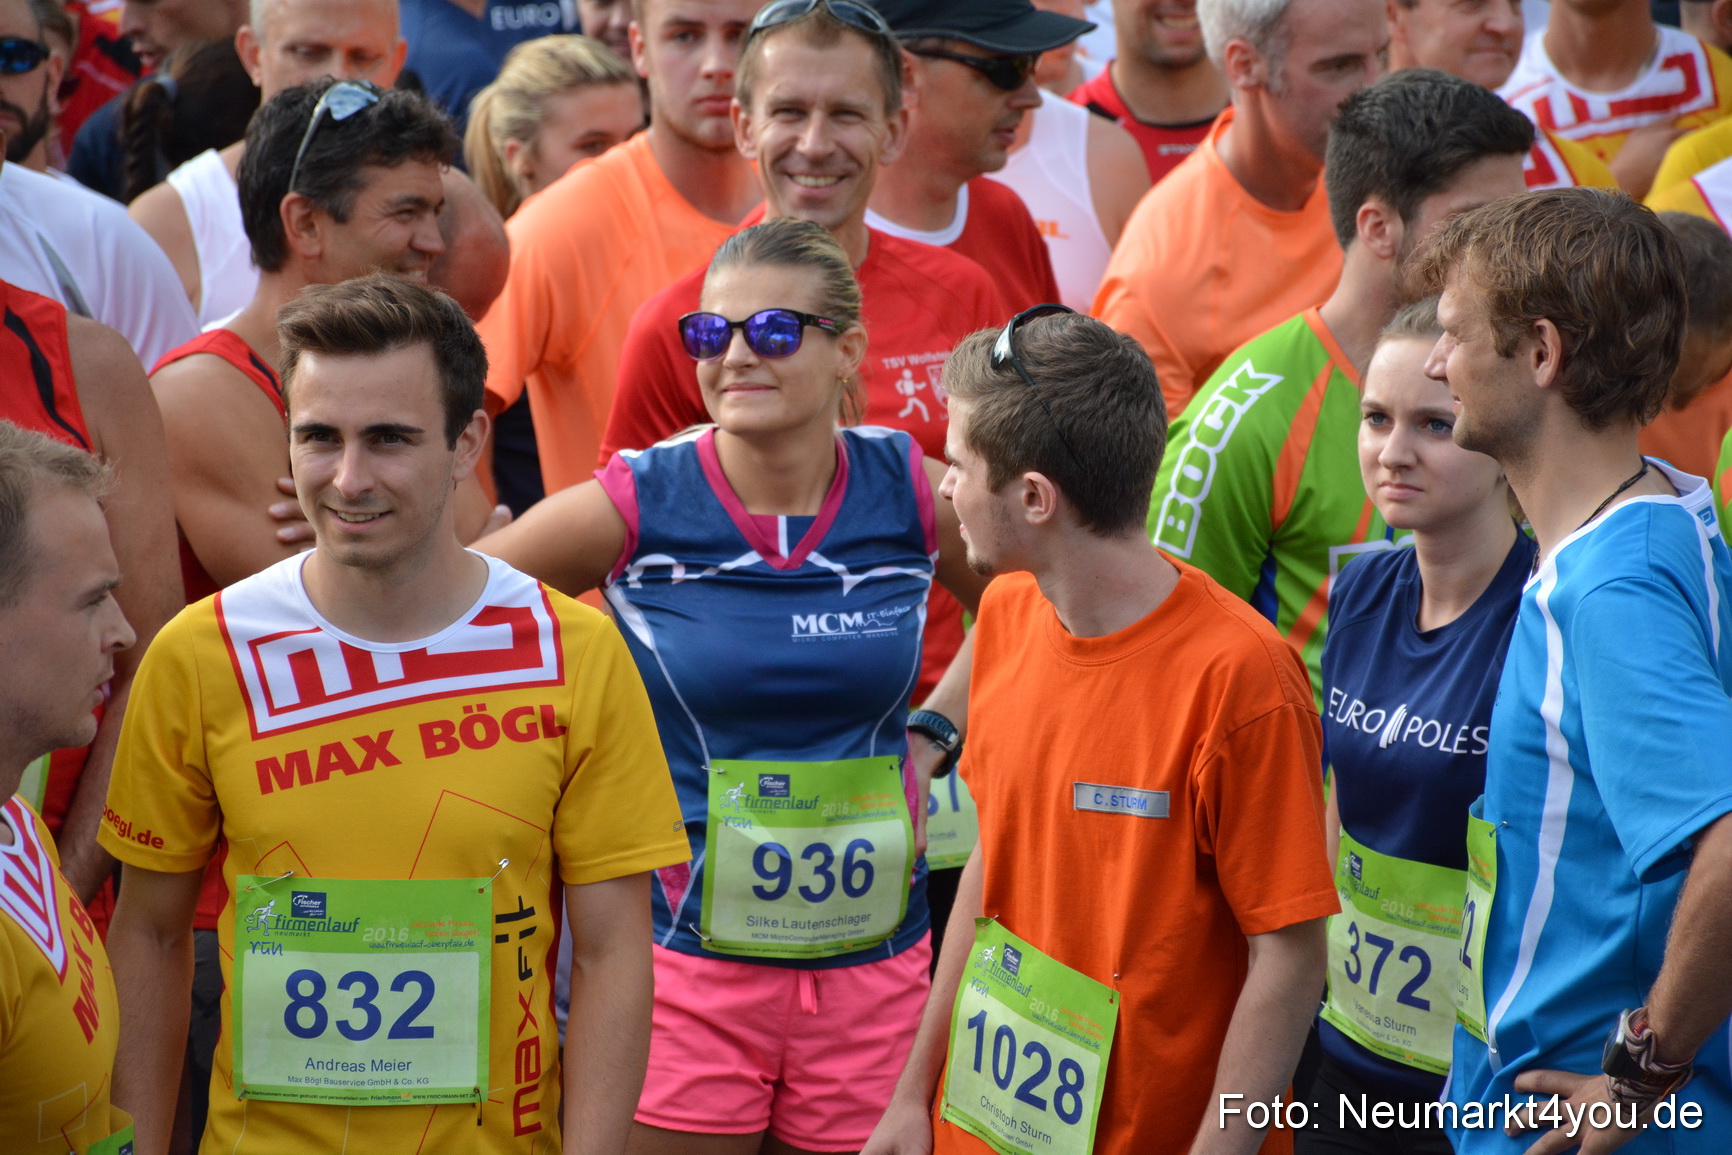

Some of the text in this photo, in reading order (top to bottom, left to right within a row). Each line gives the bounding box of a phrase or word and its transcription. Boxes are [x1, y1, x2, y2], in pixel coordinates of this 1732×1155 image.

[490, 3, 559, 30] EURO
[1153, 358, 1285, 560] BOCK
[792, 612, 863, 634] MCM
[1329, 686, 1489, 755] EURO POLES
[255, 702, 568, 796] MAX BÖGL
[744, 795, 820, 812] firmenlauf
[821, 802, 849, 817] 2016
[751, 838, 876, 903] 936
[292, 894, 322, 906] Fischer
[1381, 898, 1415, 918] 2016
[275, 917, 361, 933] firmenlauf
[746, 912, 872, 930] Silke Lautenschlager
[362, 927, 410, 942] 2016
[1344, 921, 1432, 1012] 372
[991, 960, 1033, 998] firmenlauf
[284, 969, 435, 1041] 832
[1029, 997, 1060, 1022] 2016
[1384, 1016, 1417, 1037] Sturm
[304, 1057, 412, 1073] Andreas Meier
[967, 1009, 1085, 1125] 1028
[304, 1076, 322, 1086] Bögl
[324, 1077, 366, 1087] Bauservice
[367, 1078, 392, 1086] GmbH
[394, 1078, 399, 1086] &
[402, 1078, 414, 1086] Co.
[416, 1077, 429, 1085] KG
[980, 1095, 1018, 1130] Christoph
[1020, 1121, 1053, 1145] Sturm
